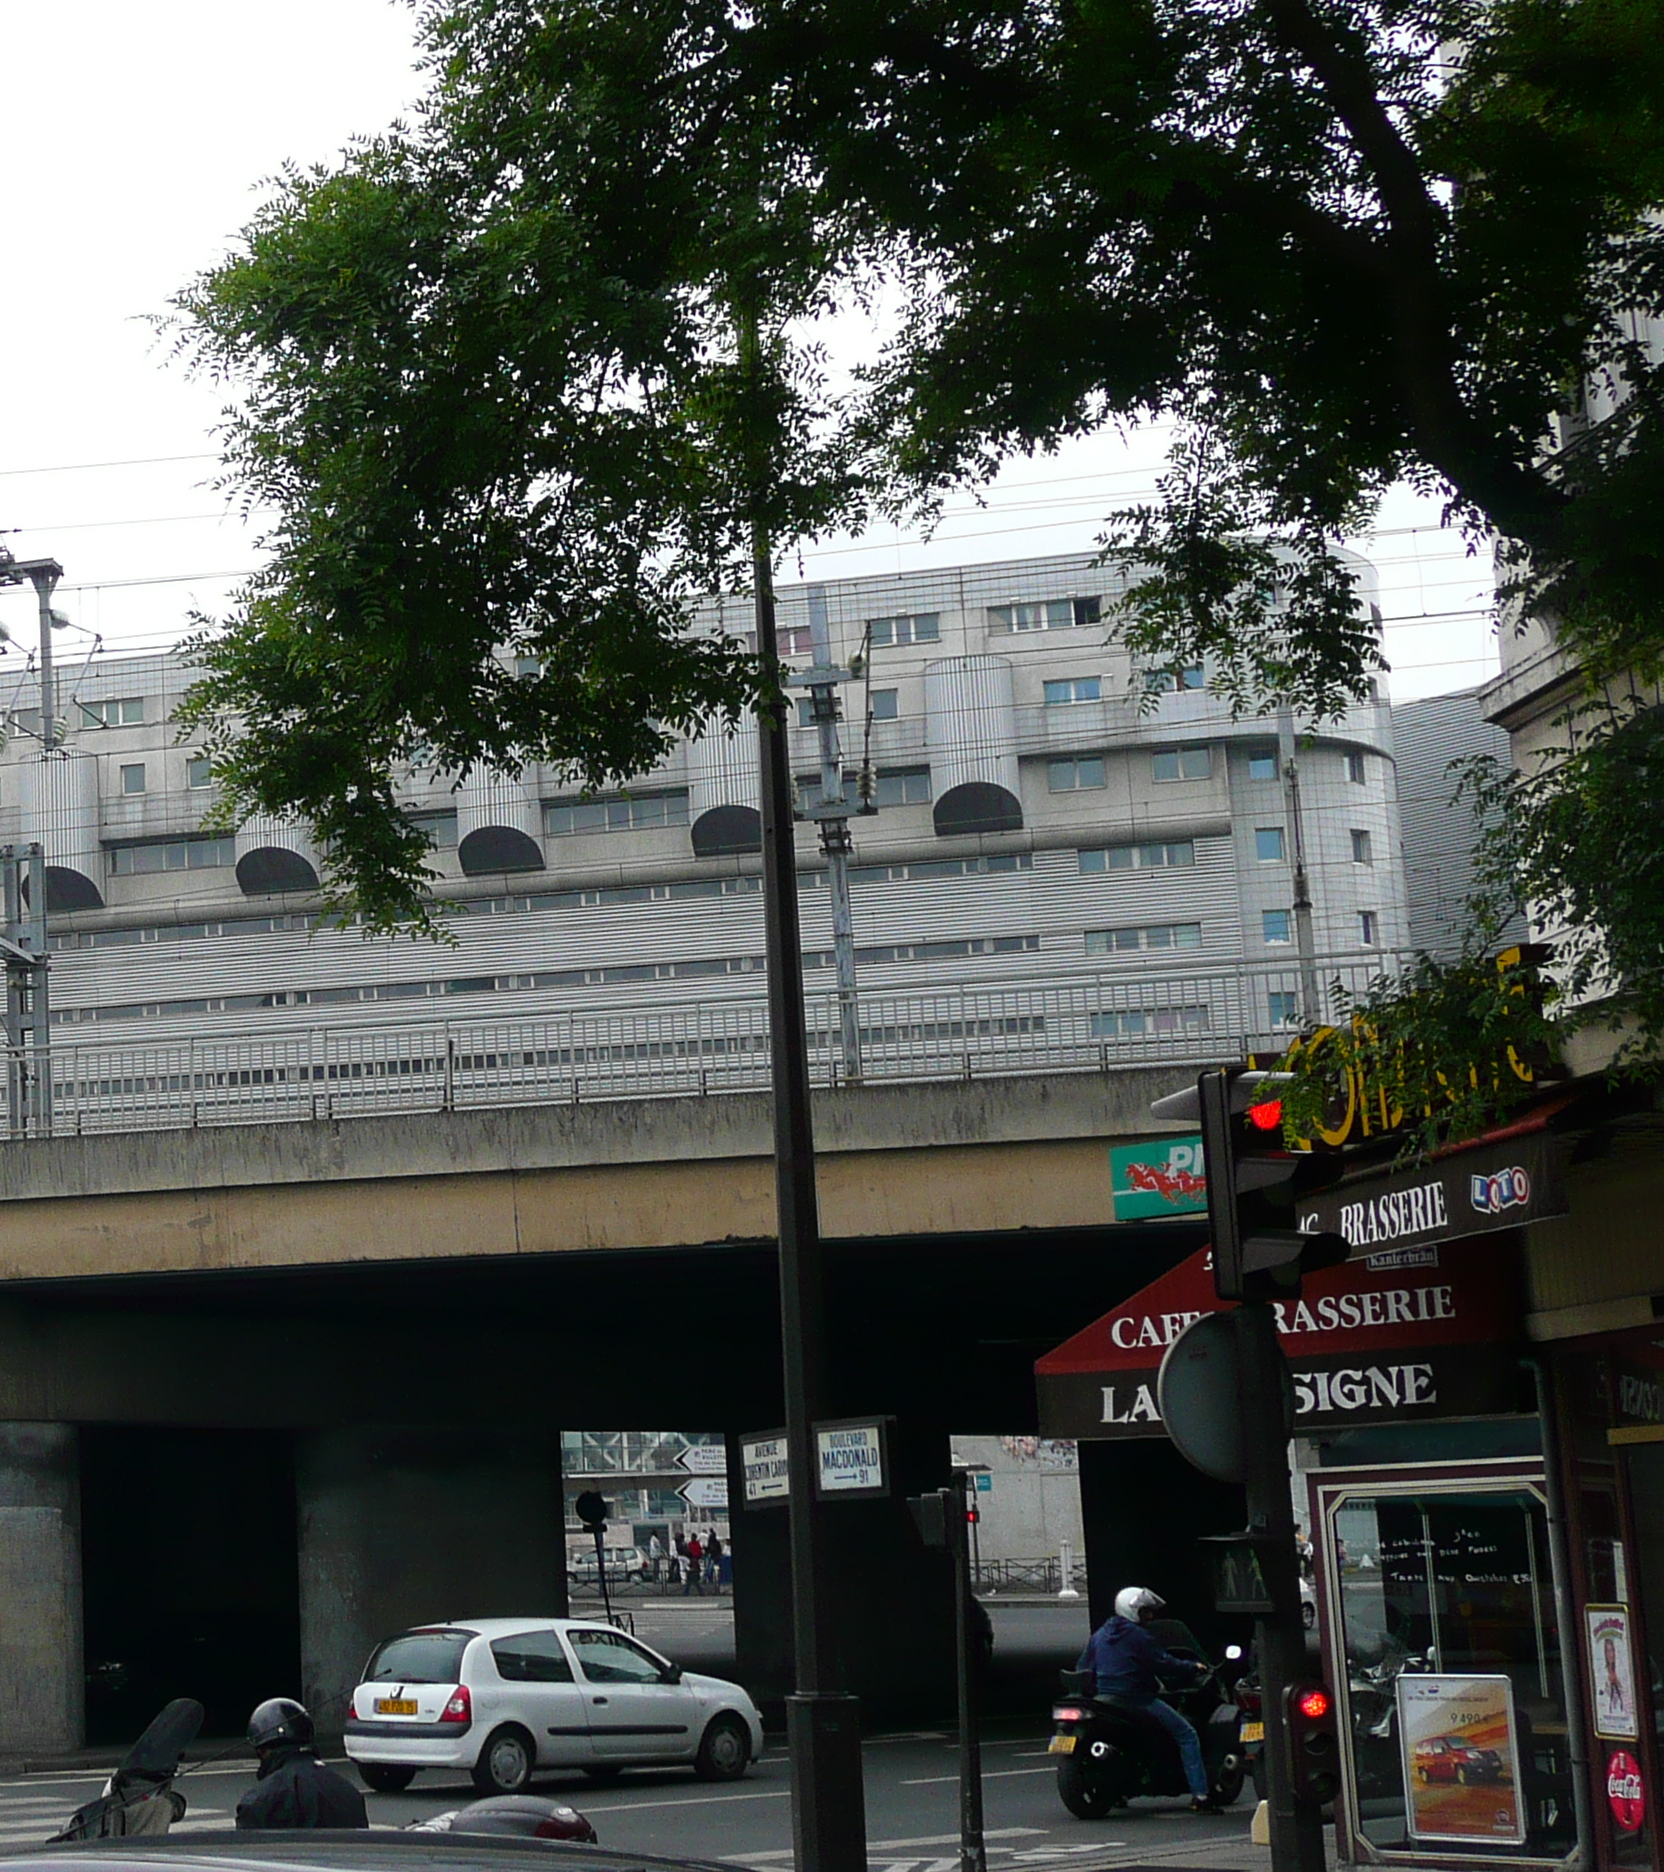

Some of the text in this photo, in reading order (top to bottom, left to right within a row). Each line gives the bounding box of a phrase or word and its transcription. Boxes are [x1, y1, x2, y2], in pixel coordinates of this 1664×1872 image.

[1472, 1167, 1530, 1213] LOTO
[1340, 1181, 1448, 1246] BRASSERIE
[1274, 1286, 1456, 1334] RASSERIE
[1100, 1364, 1437, 1424] LA SIGNE
[829, 1432, 868, 1448] BOULEVARD
[822, 1448, 878, 1470] MACDONALD
[749, 1483, 757, 1496] 41
[859, 1469, 869, 1484] 91
